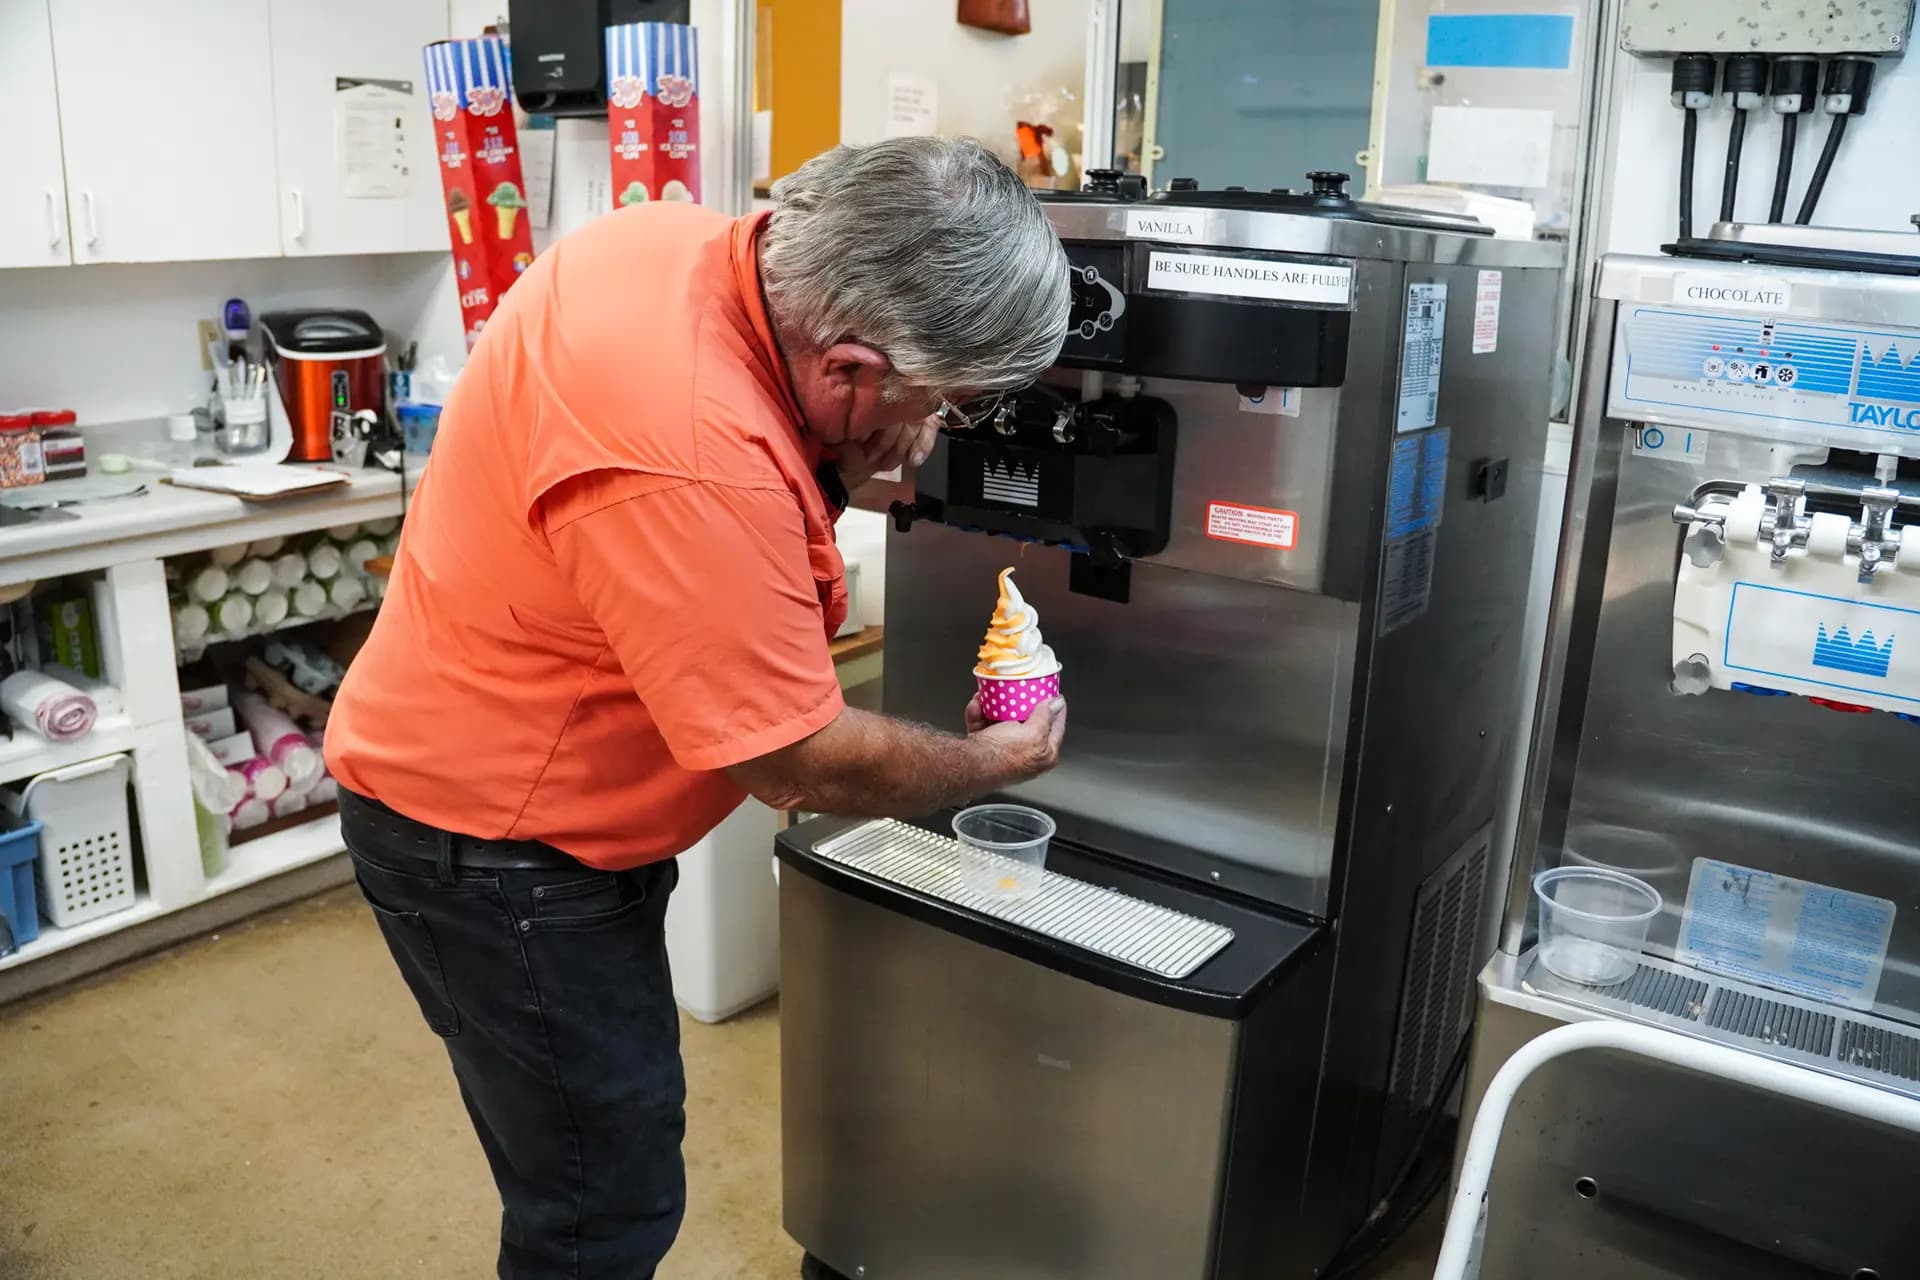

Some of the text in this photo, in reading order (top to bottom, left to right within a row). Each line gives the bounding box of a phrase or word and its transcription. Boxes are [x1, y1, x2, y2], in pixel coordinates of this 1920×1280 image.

[1138, 220, 1193, 235] VANILLA
[1155, 260, 1172, 273] BE
[1174, 262, 1210, 277] SURE
[1213, 265, 1279, 282] HANDLES
[1281, 271, 1308, 285] ARE
[1687, 286, 1784, 305] CHOCOLATE
[1214, 507, 1243, 517] CAUTION
